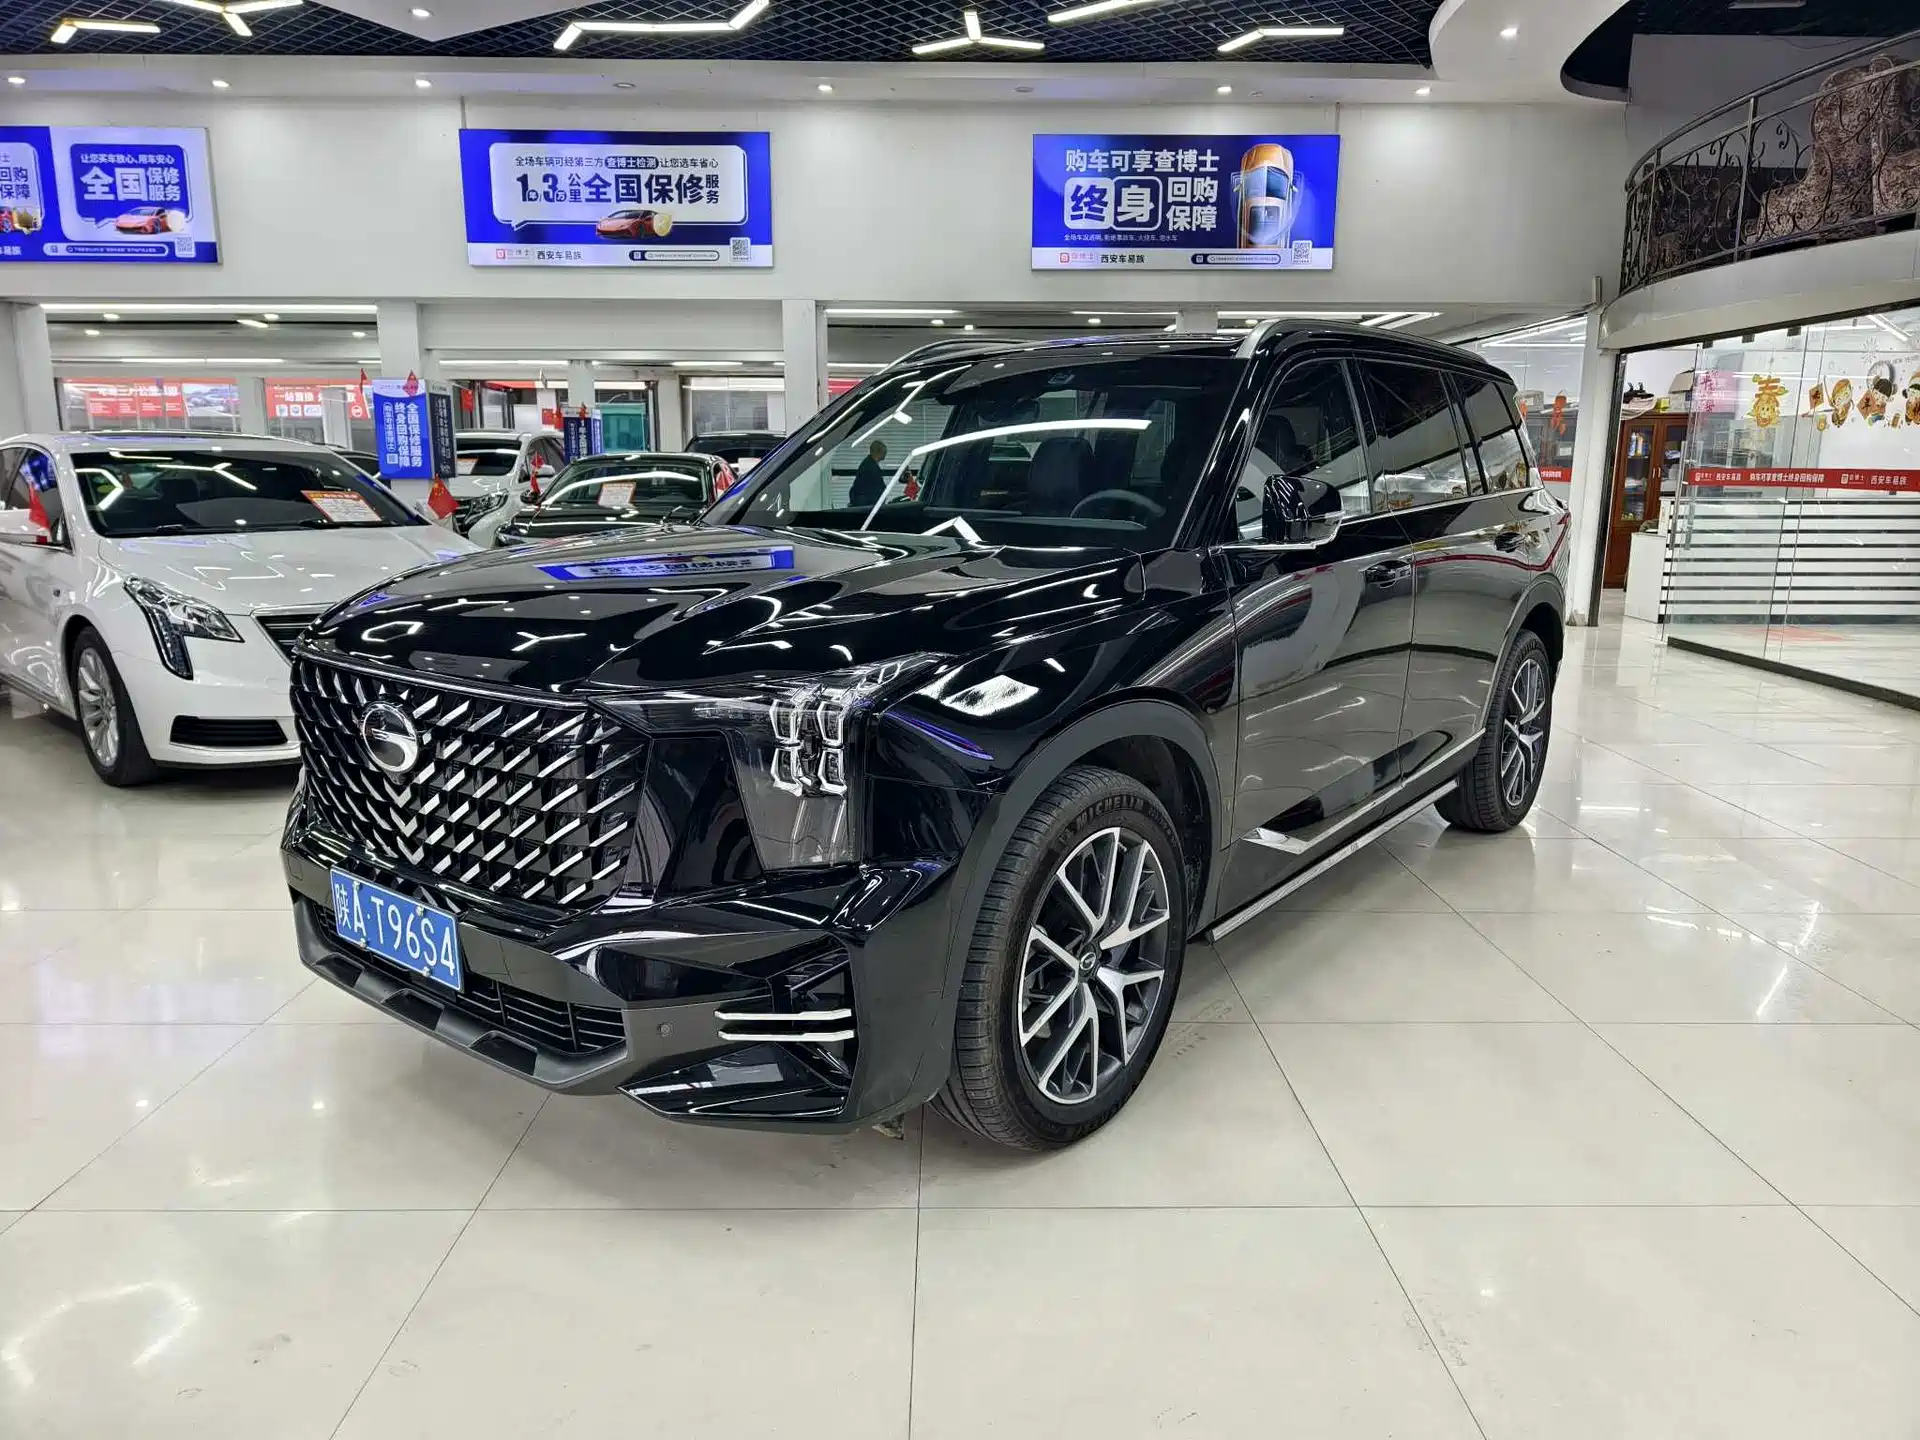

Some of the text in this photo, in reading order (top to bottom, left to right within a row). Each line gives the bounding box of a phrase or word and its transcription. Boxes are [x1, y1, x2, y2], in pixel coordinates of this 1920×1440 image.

[1065, 149, 1220, 172] 购车可享查博士
[0, 167, 28, 182] 回购
[0, 184, 30, 199] 保障
[1070, 177, 1218, 223] 终身 回购
[1166, 205, 1217, 231] 保障
